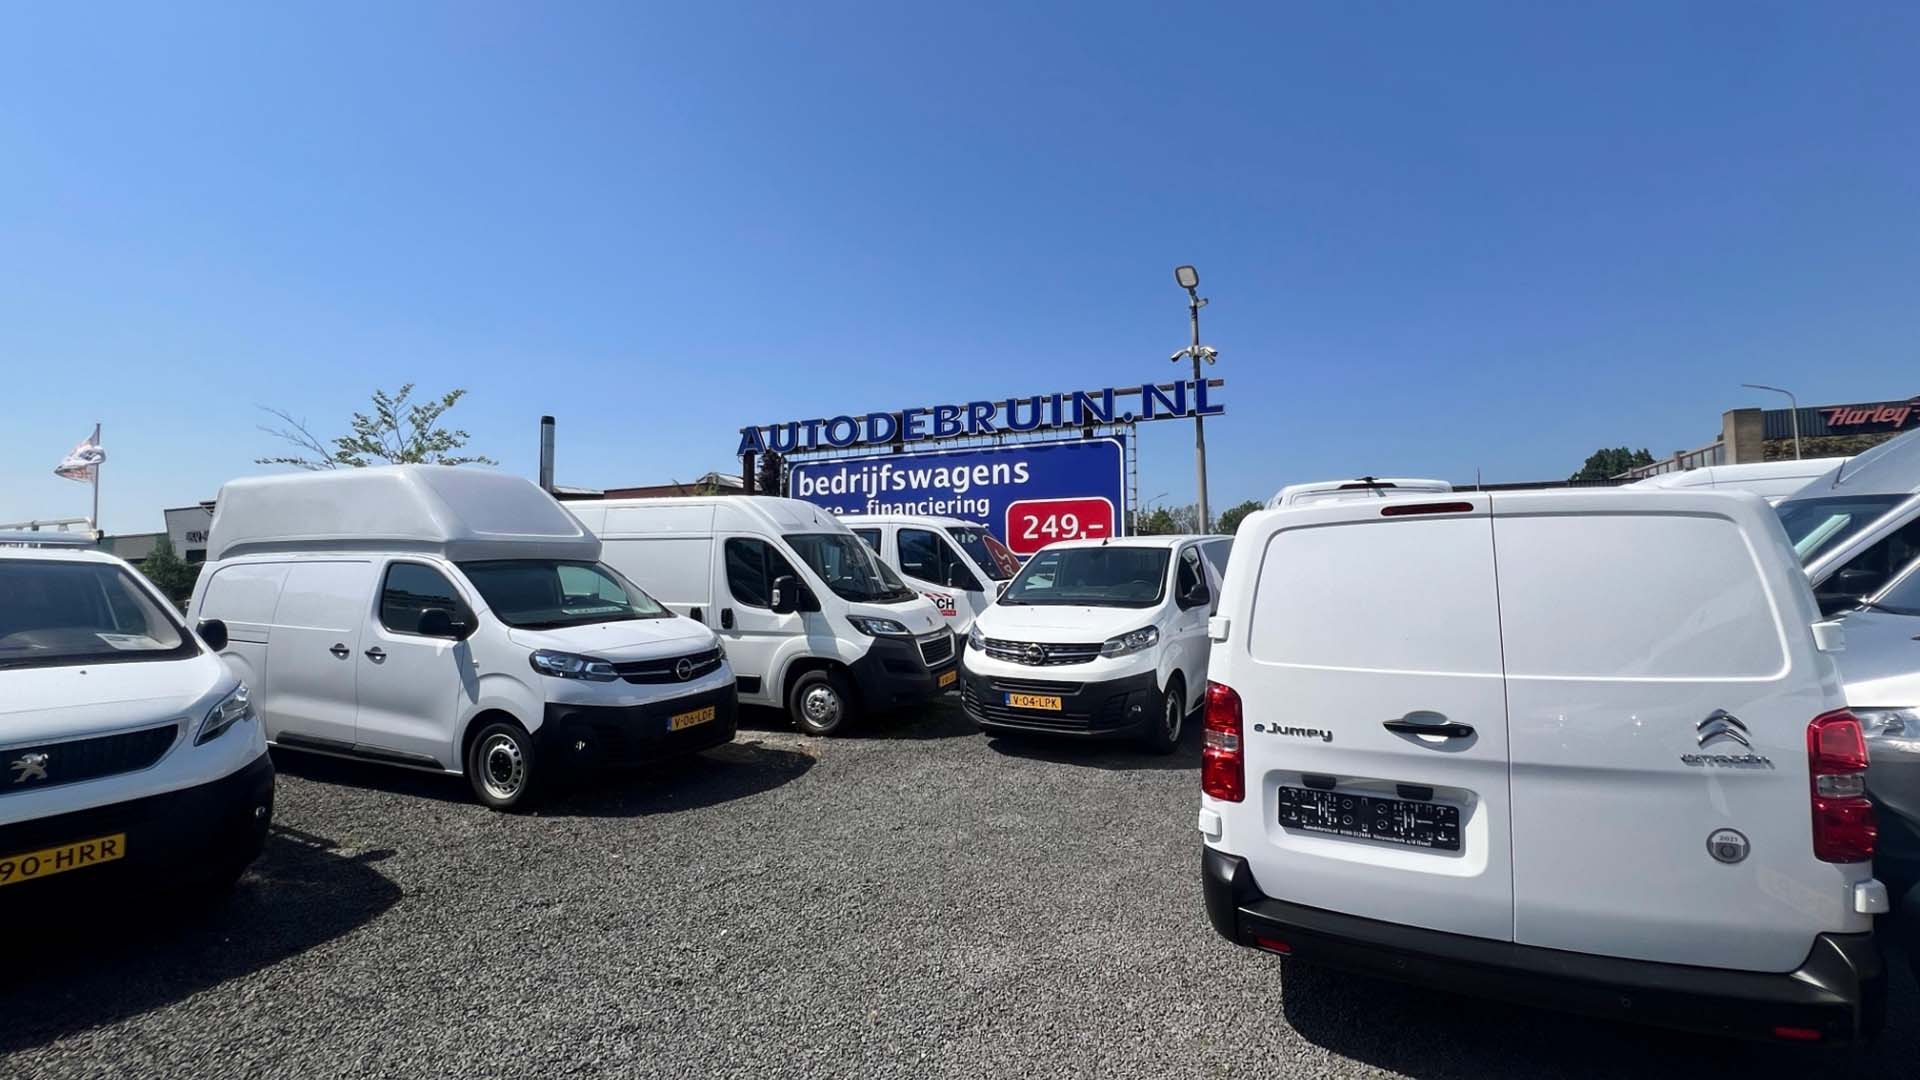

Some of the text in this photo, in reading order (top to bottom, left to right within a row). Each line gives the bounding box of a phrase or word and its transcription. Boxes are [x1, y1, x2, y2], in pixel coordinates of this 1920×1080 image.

[737, 378, 1226, 455] AUTODEBRUIN.NL
[1819, 406, 1912, 428] Harley
[799, 461, 1030, 498] bedrijfswagens
[866, 496, 990, 517] financiering
[1013, 695, 1058, 709] V-04-LPK
